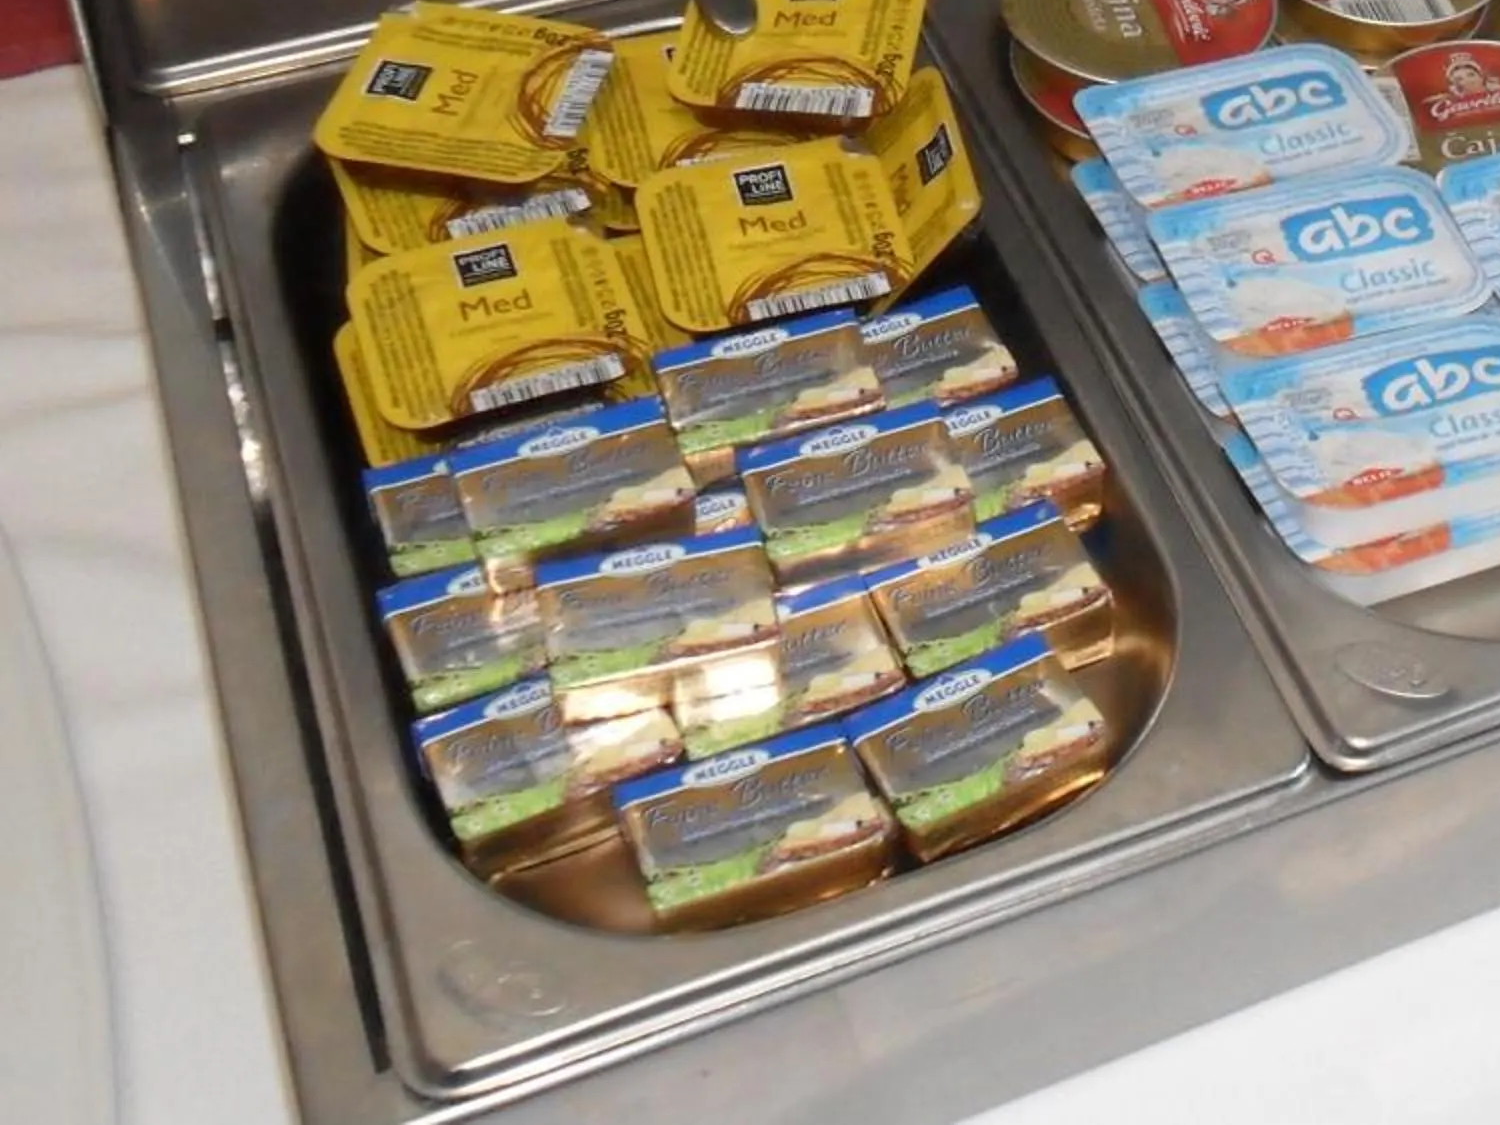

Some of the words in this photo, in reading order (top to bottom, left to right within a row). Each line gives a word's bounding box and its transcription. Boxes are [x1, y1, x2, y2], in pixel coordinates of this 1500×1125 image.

[774, 10, 837, 28] Med
[431, 68, 479, 116] Med
[1217, 80, 1335, 127] abc
[1260, 121, 1350, 157] Classic
[738, 170, 784, 186] PROFI
[750, 181, 786, 195] LINE
[738, 210, 808, 237] Med
[1298, 206, 1421, 254] abc
[1340, 257, 1436, 293] Classic
[459, 288, 534, 322] Med
[864, 316, 912, 338] MEGGLE
[722, 332, 779, 354] MEGGLE
[950, 409, 992, 429] EGGLE
[530, 430, 588, 453] MEGGLE
[810, 428, 868, 452] MEGGLE
[843, 442, 930, 476] Butter
[699, 496, 737, 516] GGLE
[611, 550, 673, 570] MEGGLE
[929, 538, 983, 564] MEGGLE
[781, 621, 847, 651] utter
[496, 688, 549, 713] MEGGL
[925, 674, 982, 704] MEGGLE
[694, 754, 757, 781] MEGGLE
